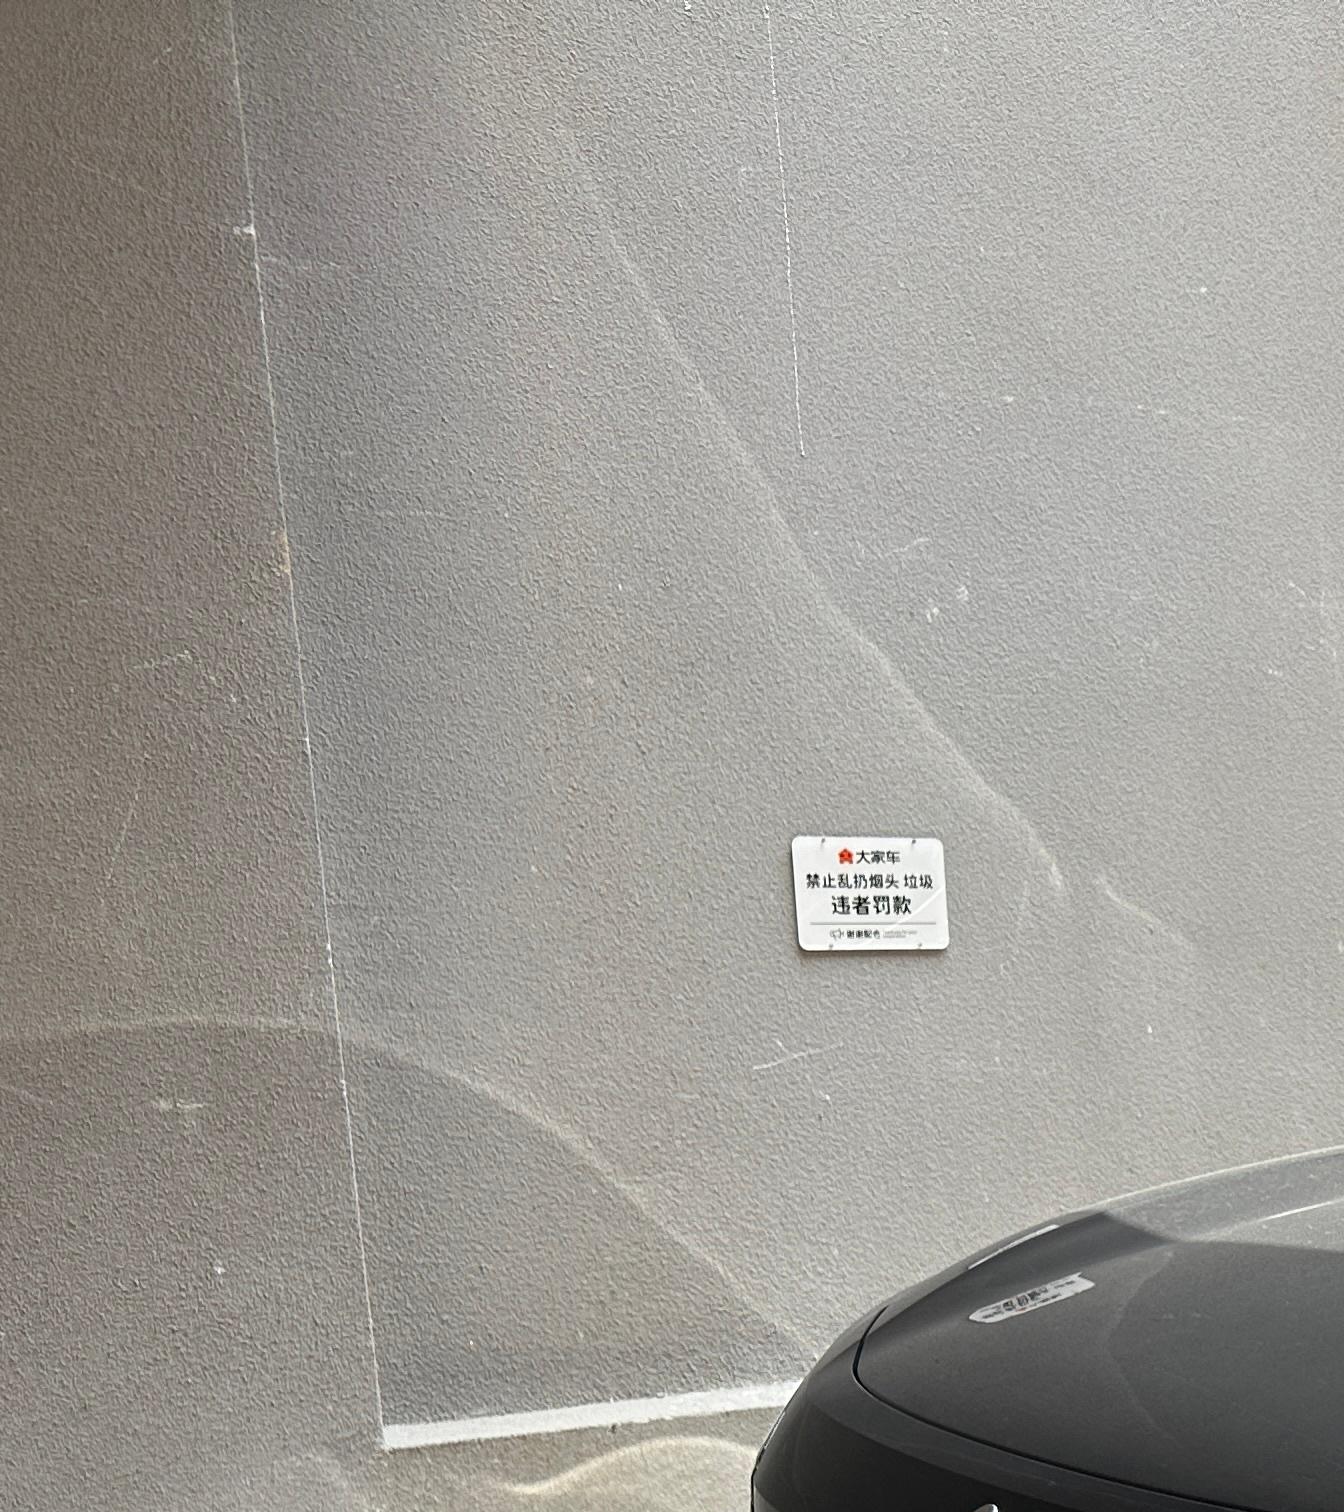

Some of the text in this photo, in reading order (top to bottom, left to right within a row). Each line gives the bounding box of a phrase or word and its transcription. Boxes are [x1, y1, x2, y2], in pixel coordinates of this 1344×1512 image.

[855, 850, 901, 865] 大家车
[806, 873, 934, 890] 禁止乱扔烟头 垃圾
[831, 895, 912, 915] 违者罚款
